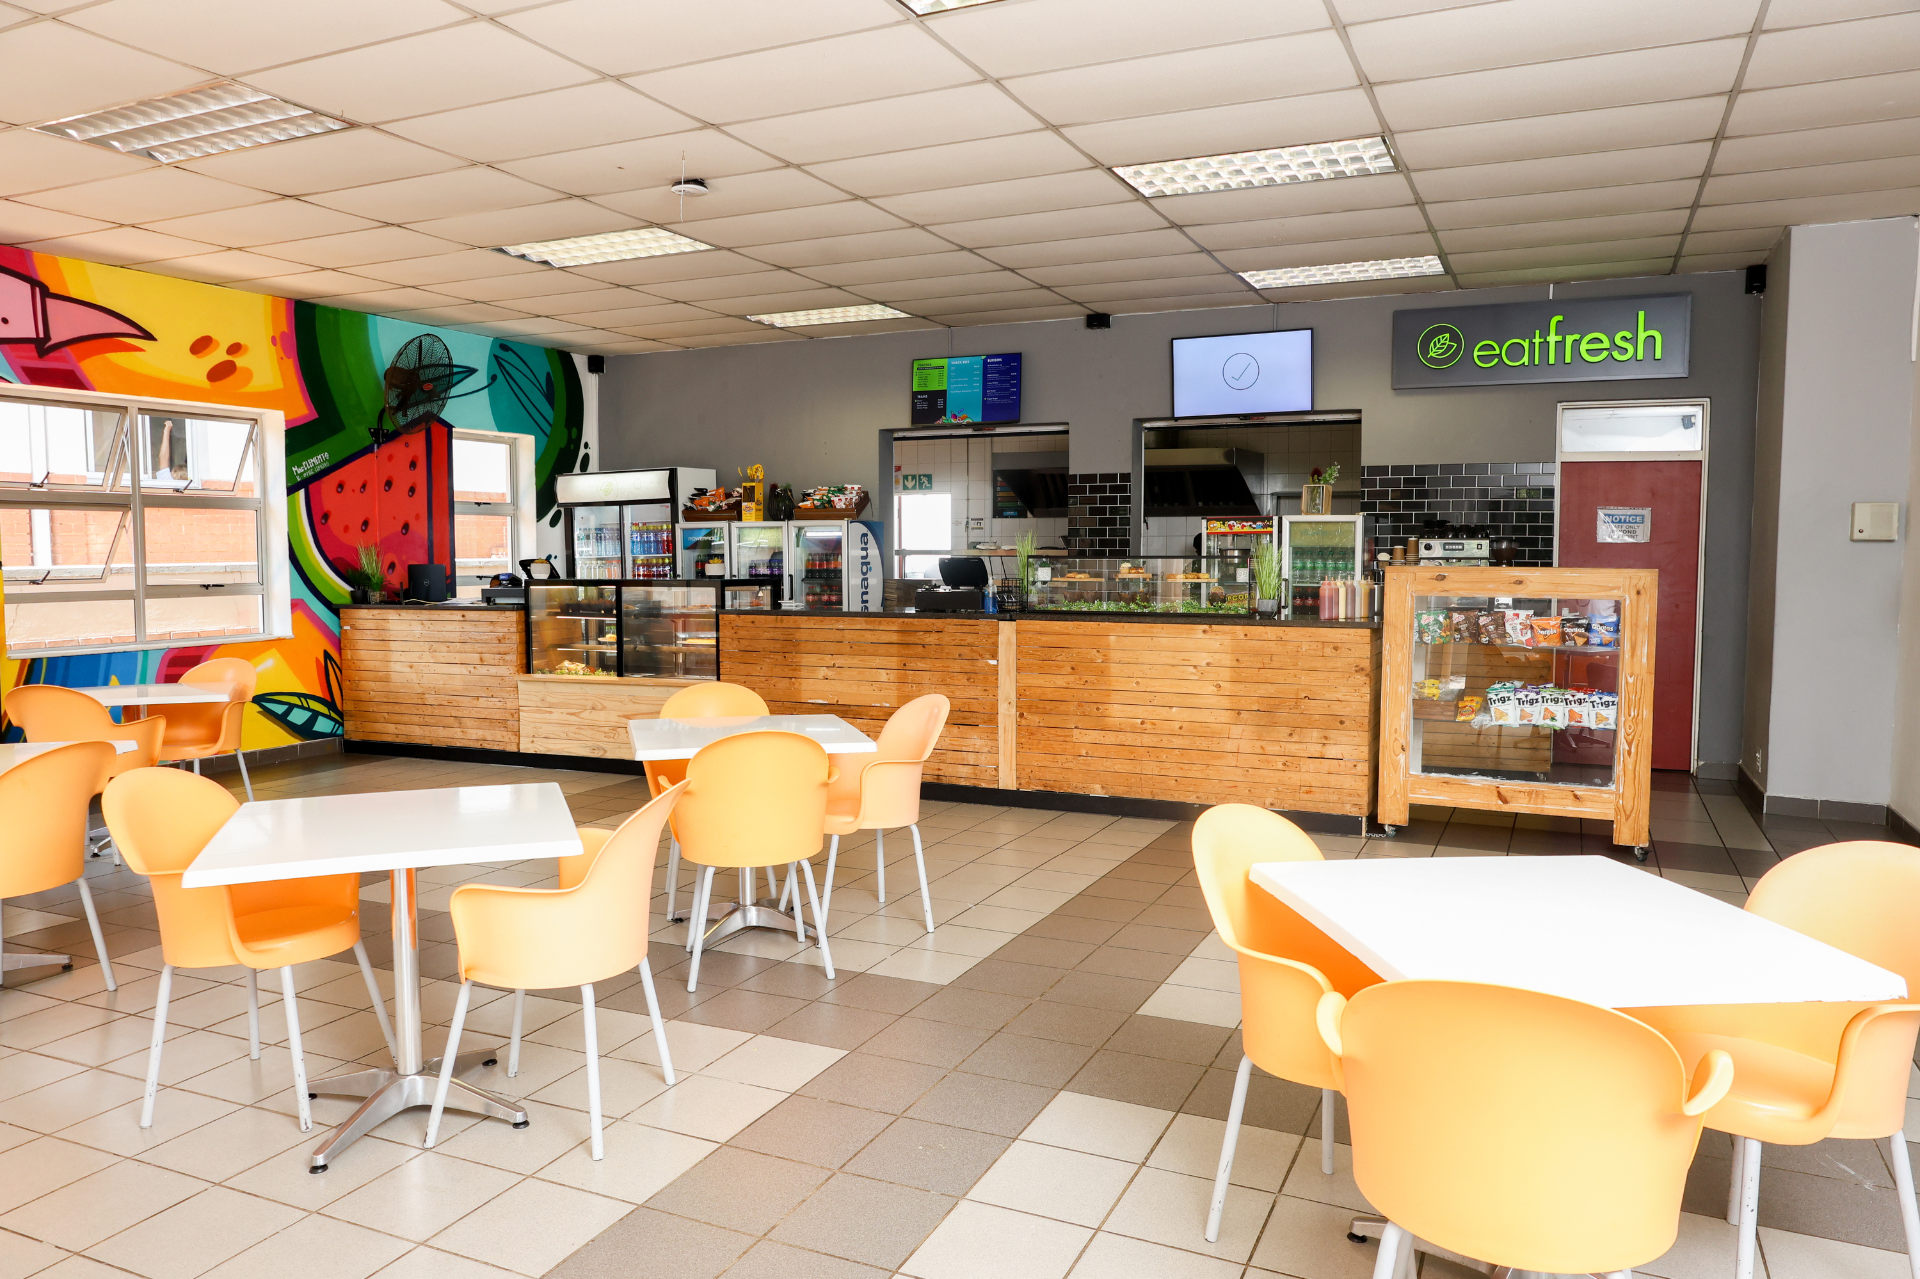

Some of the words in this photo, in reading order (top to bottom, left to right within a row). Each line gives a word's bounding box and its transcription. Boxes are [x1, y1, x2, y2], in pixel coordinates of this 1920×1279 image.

[1605, 515, 1643, 523] NOTICE
[1488, 695, 1512, 706] Trigz
[1516, 697, 1540, 706] Trigz
[1590, 700, 1616, 709] Trigz
